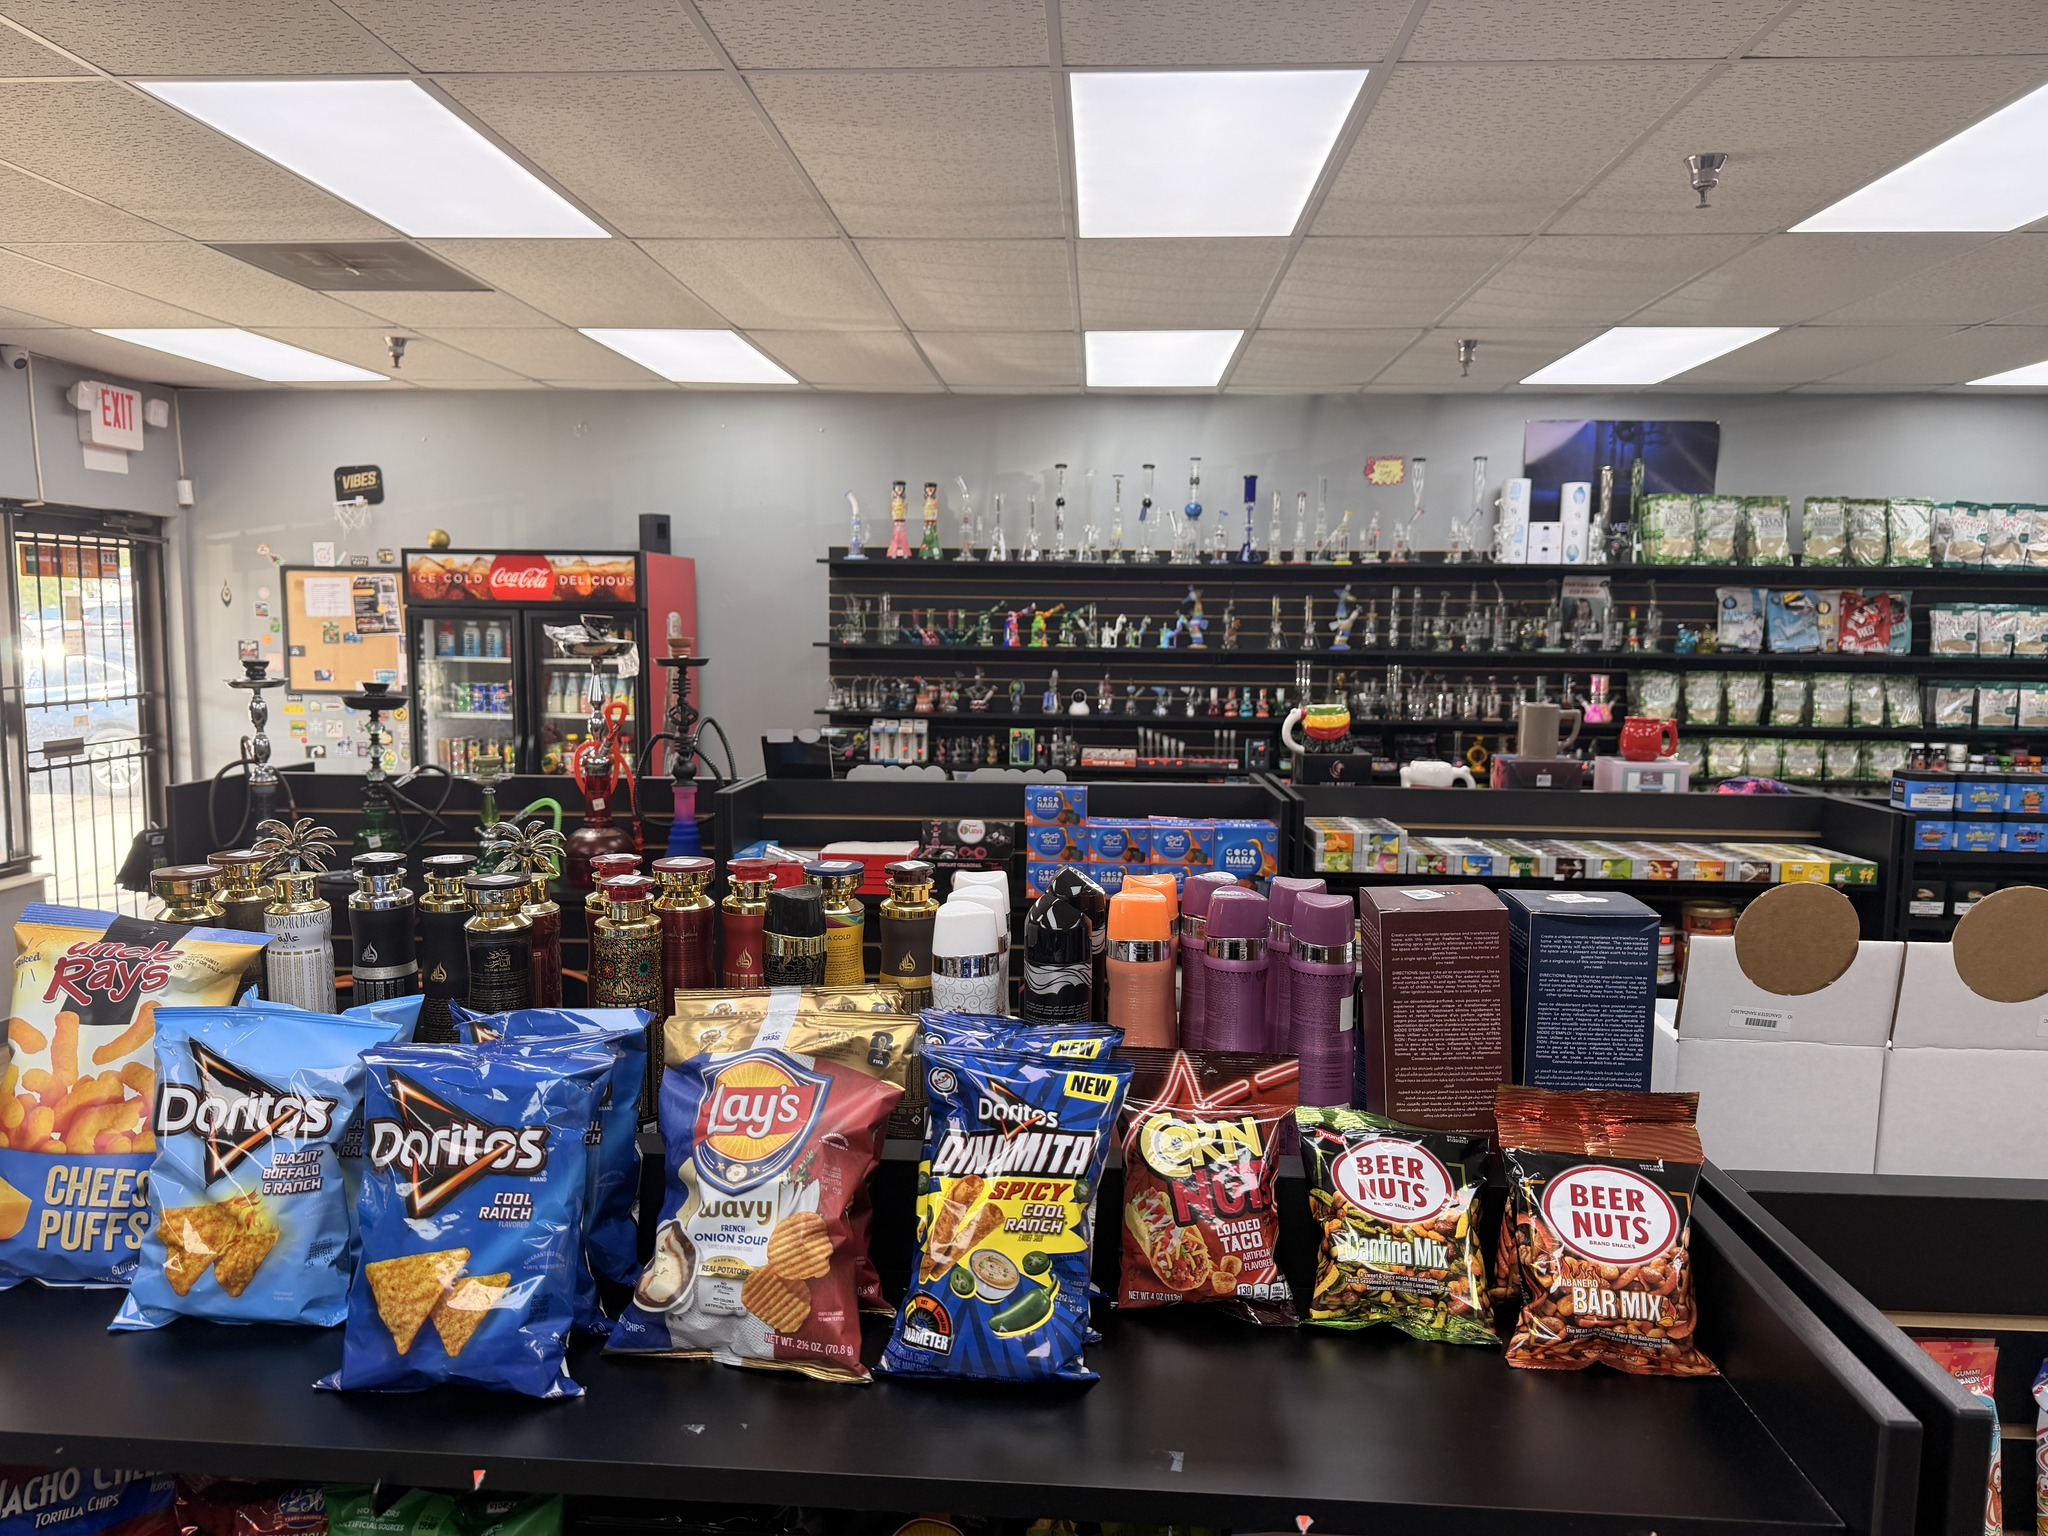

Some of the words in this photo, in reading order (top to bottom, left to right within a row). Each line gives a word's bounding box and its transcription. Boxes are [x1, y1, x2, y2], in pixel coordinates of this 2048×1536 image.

[101, 388, 134, 431] EXIT
[342, 471, 377, 490] VIBES
[412, 573, 436, 584] ICE
[443, 573, 483, 584] COLD
[559, 574, 634, 587] DELICIOUS
[1226, 848, 1256, 856] COCO
[1226, 856, 1256, 865] NARA
[277, 932, 300, 945] عالية
[833, 933, 851, 941] GOLD
[67, 941, 184, 962] uncle
[42, 956, 171, 1006] Ray's
[1757, 1011, 1782, 1019] GANGSTER
[762, 1034, 781, 1042] 1938
[1056, 1040, 1099, 1057] NEW
[1070, 1075, 1112, 1097] NEW
[157, 1084, 336, 1137] Doritos
[706, 1083, 800, 1140] Lay's
[977, 1098, 1059, 1129] Doritos
[371, 1119, 548, 1172] Doritos
[932, 1130, 1095, 1176] DINAMITA
[1140, 1112, 1267, 1178] CORN
[272, 1150, 322, 1166] BLAZIN'
[262, 1164, 321, 1181] BUFFALO
[1356, 1155, 1425, 1181] BEER
[44, 1164, 151, 1208] CHEES
[272, 1177, 322, 1195] RANCH
[988, 1181, 1072, 1202] SPICY
[1171, 1160, 1272, 1223] NUTS
[1357, 1178, 1428, 1208] NUTS
[494, 1191, 532, 1206] COOL
[1395, 1202, 1416, 1211] SNACKS
[1570, 1183, 1646, 1213] BEER
[478, 1205, 532, 1221] RANCH
[698, 1199, 772, 1226] wavy
[1022, 1203, 1066, 1219] COOL
[37, 1209, 149, 1251] PUFFS
[721, 1224, 746, 1233] FRENCH
[1004, 1217, 1064, 1234] RANCH
[1216, 1217, 1261, 1237] LOADED
[1572, 1210, 1649, 1245] NUTS
[694, 1233, 734, 1244] ONION
[737, 1235, 769, 1246] SOUP
[1219, 1231, 1263, 1253] TACO
[1347, 1231, 1413, 1266] Cantina
[1414, 1236, 1449, 1269] Mix
[702, 1265, 716, 1273] REAL
[717, 1266, 750, 1276] POTATOES
[1244, 1258, 1274, 1272] FLAVORED
[1238, 1285, 1251, 1295] 130
[1557, 1278, 1599, 1288] HABANERO
[1128, 1290, 1139, 1300] NET
[1140, 1291, 1150, 1300] WT
[1150, 1292, 1155, 1300] 4
[1155, 1292, 1164, 1301] OZ
[1572, 1286, 1618, 1319] BAR
[1620, 1290, 1663, 1322] MIX
[625, 1321, 646, 1333] CHIPS
[764, 1333, 779, 1345] NET
[781, 1337, 795, 1348] WT.
[810, 1342, 824, 1353] OZ.
[825, 1343, 846, 1355] (70.8
[847, 1344, 854, 1356] g)
[1638, 1335, 1660, 1343] Habanero
[35, 1506, 84, 1529] TORTILLA
[87, 1493, 120, 1512] CHIPS
[378, 1523, 405, 1532] SOURCES
